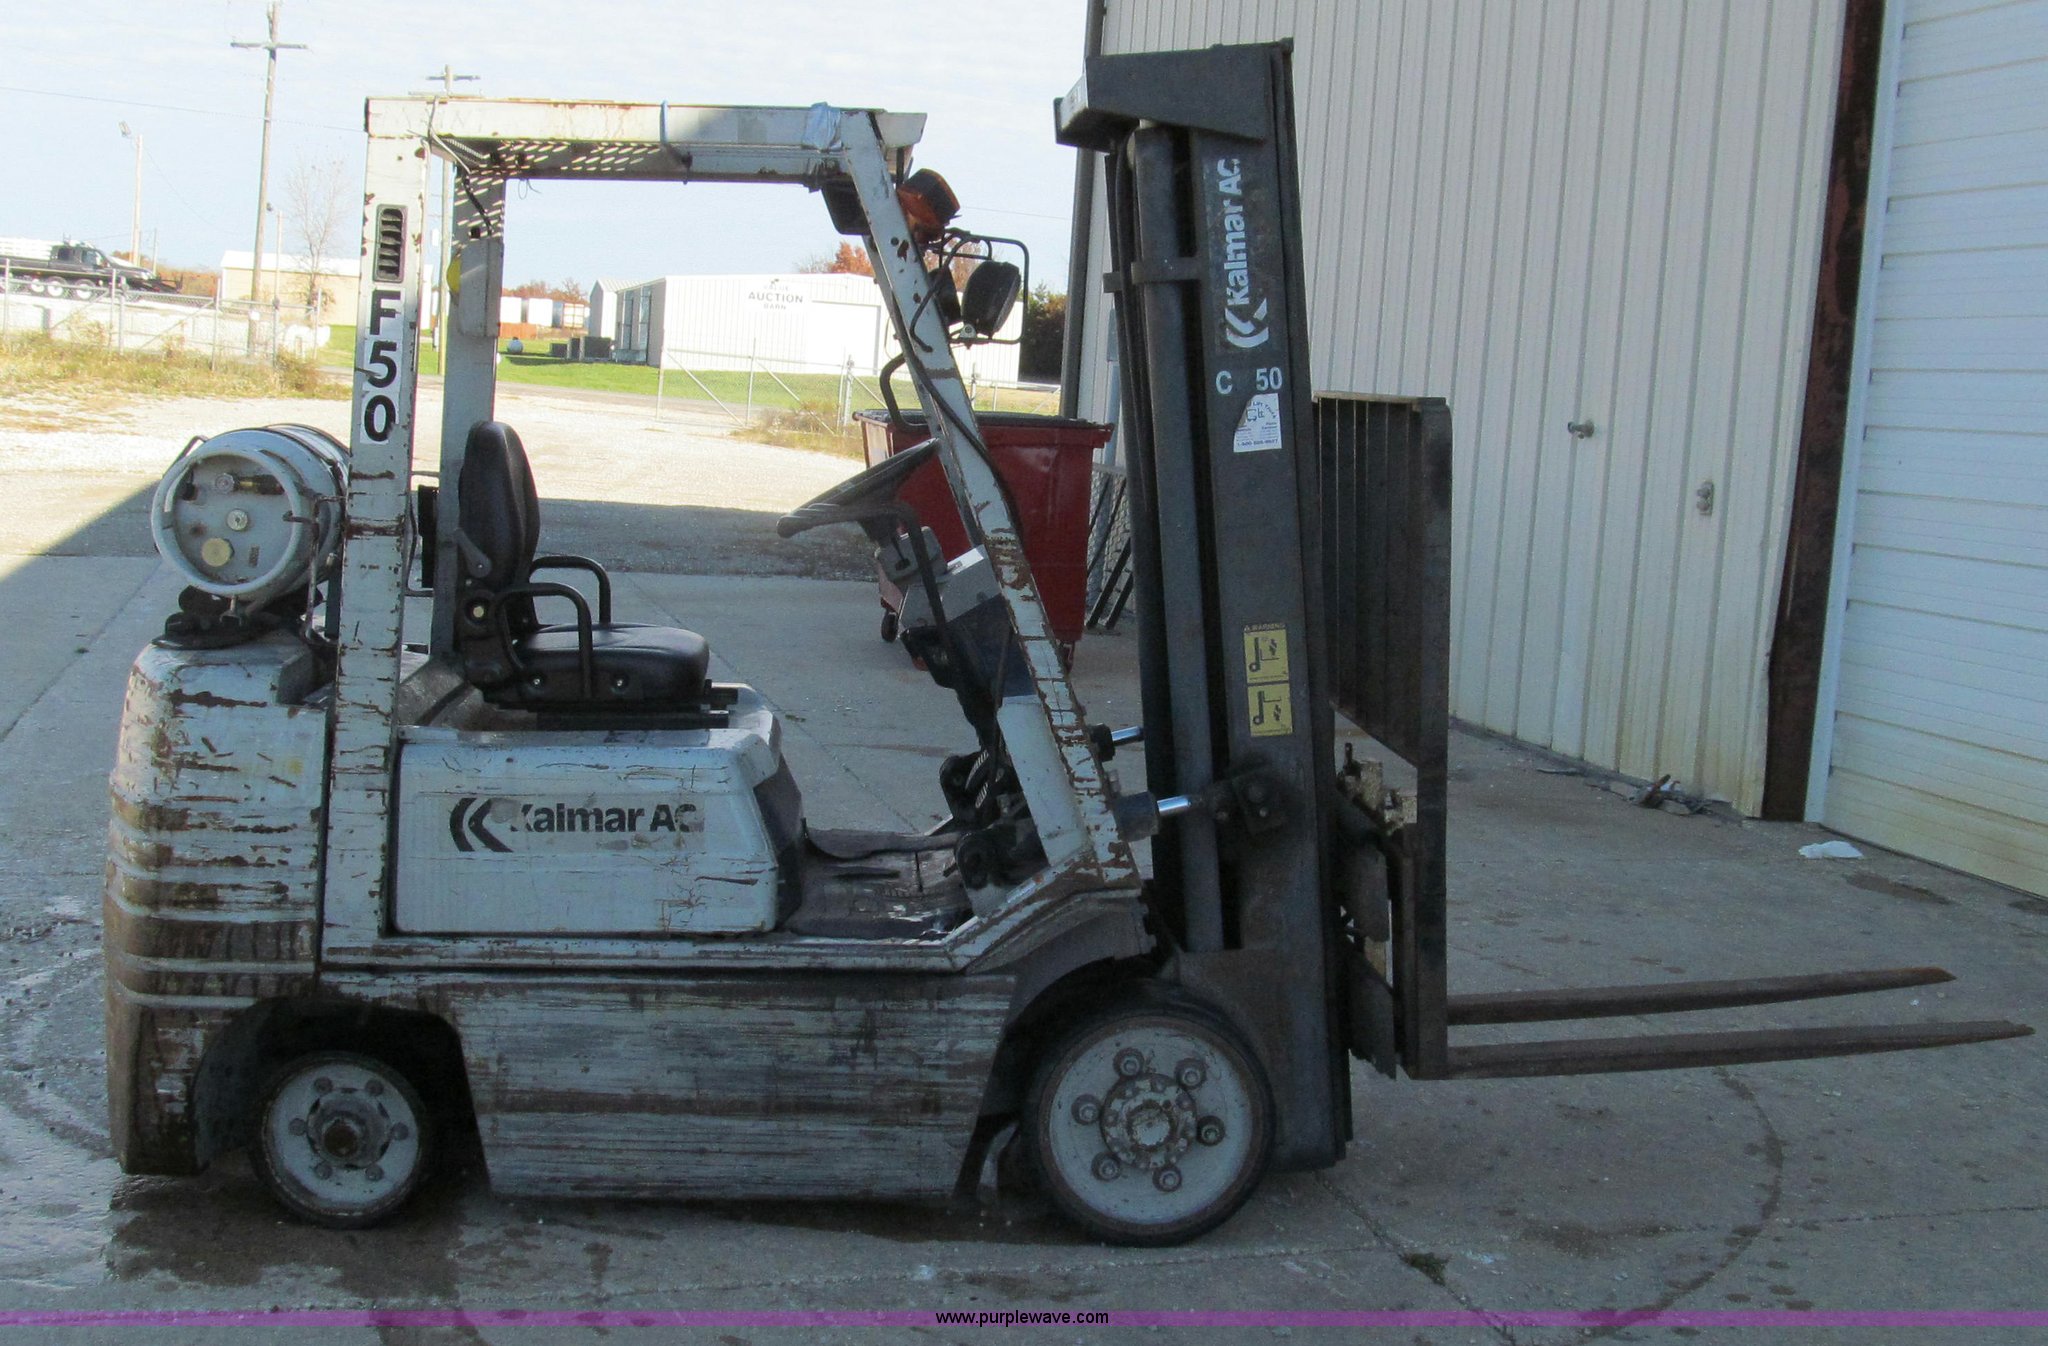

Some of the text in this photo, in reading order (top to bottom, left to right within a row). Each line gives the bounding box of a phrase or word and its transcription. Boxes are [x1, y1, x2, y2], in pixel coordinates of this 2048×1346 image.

[1216, 158, 1249, 306] Kalmar AC
[748, 291, 804, 304] AUCTION
[1215, 366, 1283, 395] C 50
